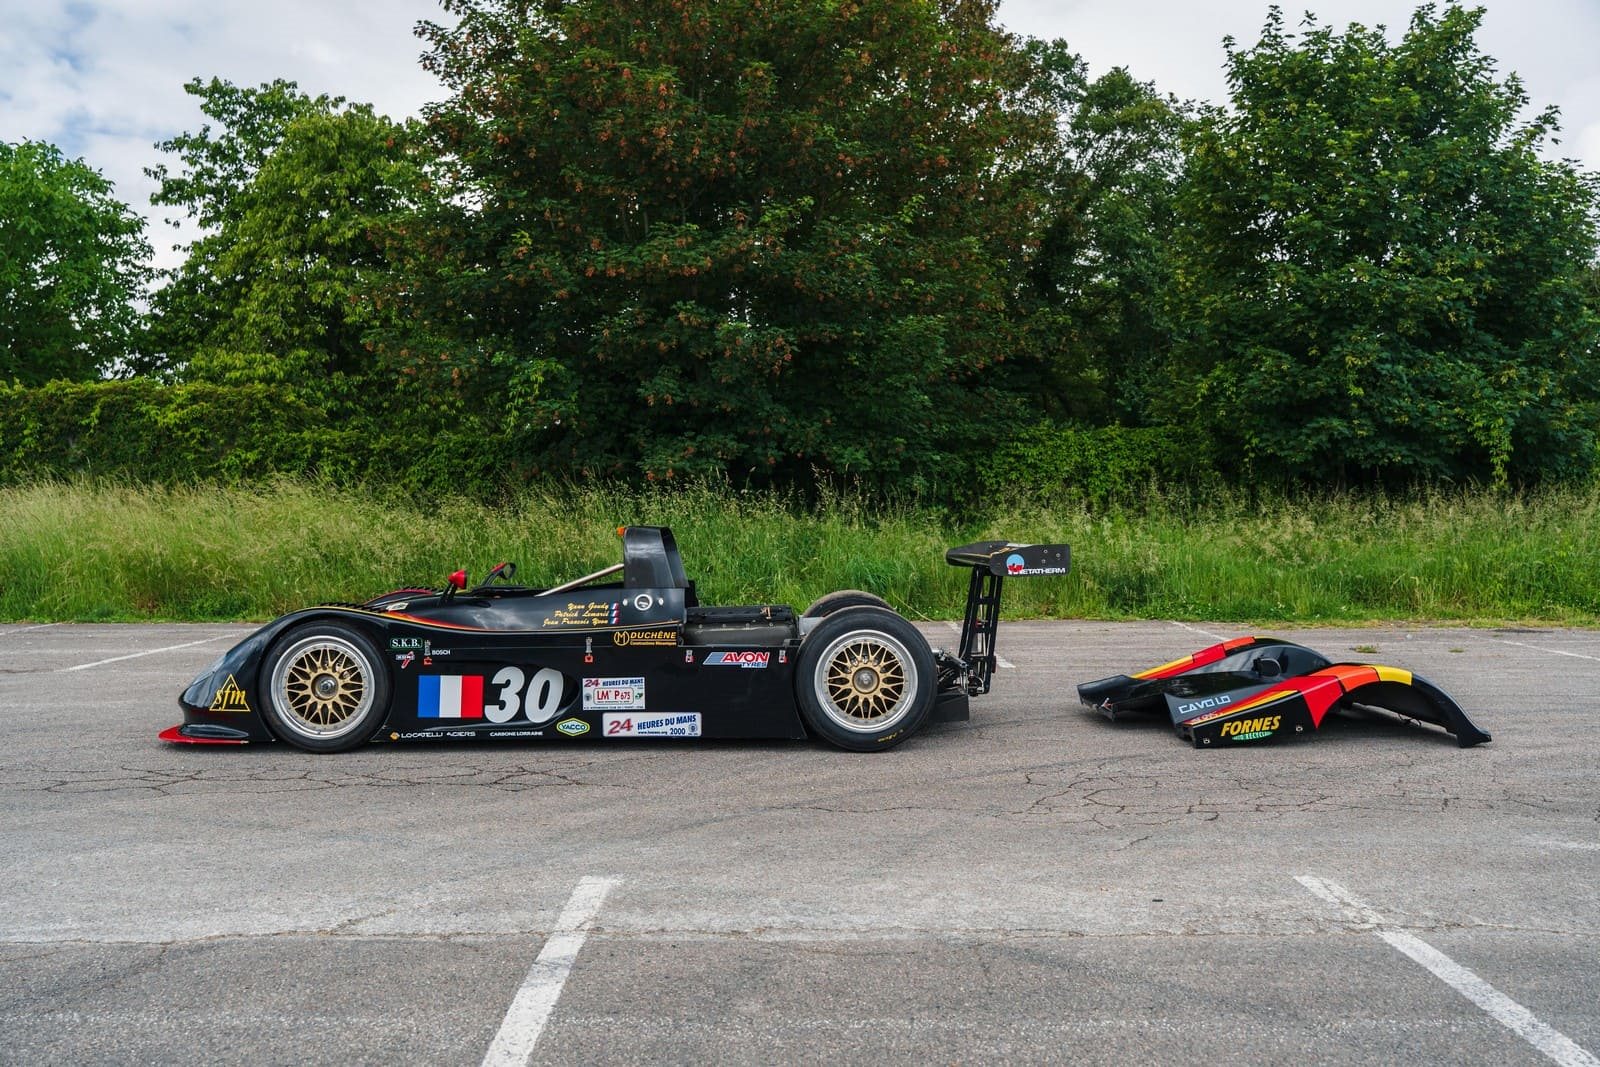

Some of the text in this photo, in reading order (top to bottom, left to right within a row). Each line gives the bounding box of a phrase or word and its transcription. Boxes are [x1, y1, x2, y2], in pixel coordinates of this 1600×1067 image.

[630, 631, 677, 639] DUCHÊNE
[391, 638, 421, 648] S.K.B.
[721, 652, 769, 662] AVON
[584, 679, 600, 688] 24
[215, 684, 246, 709] sfm
[484, 666, 564, 724] 30
[608, 714, 697, 735] 24 HEURES DU MANS
[1220, 715, 1281, 737] FORNES
[669, 727, 686, 735] 2000
